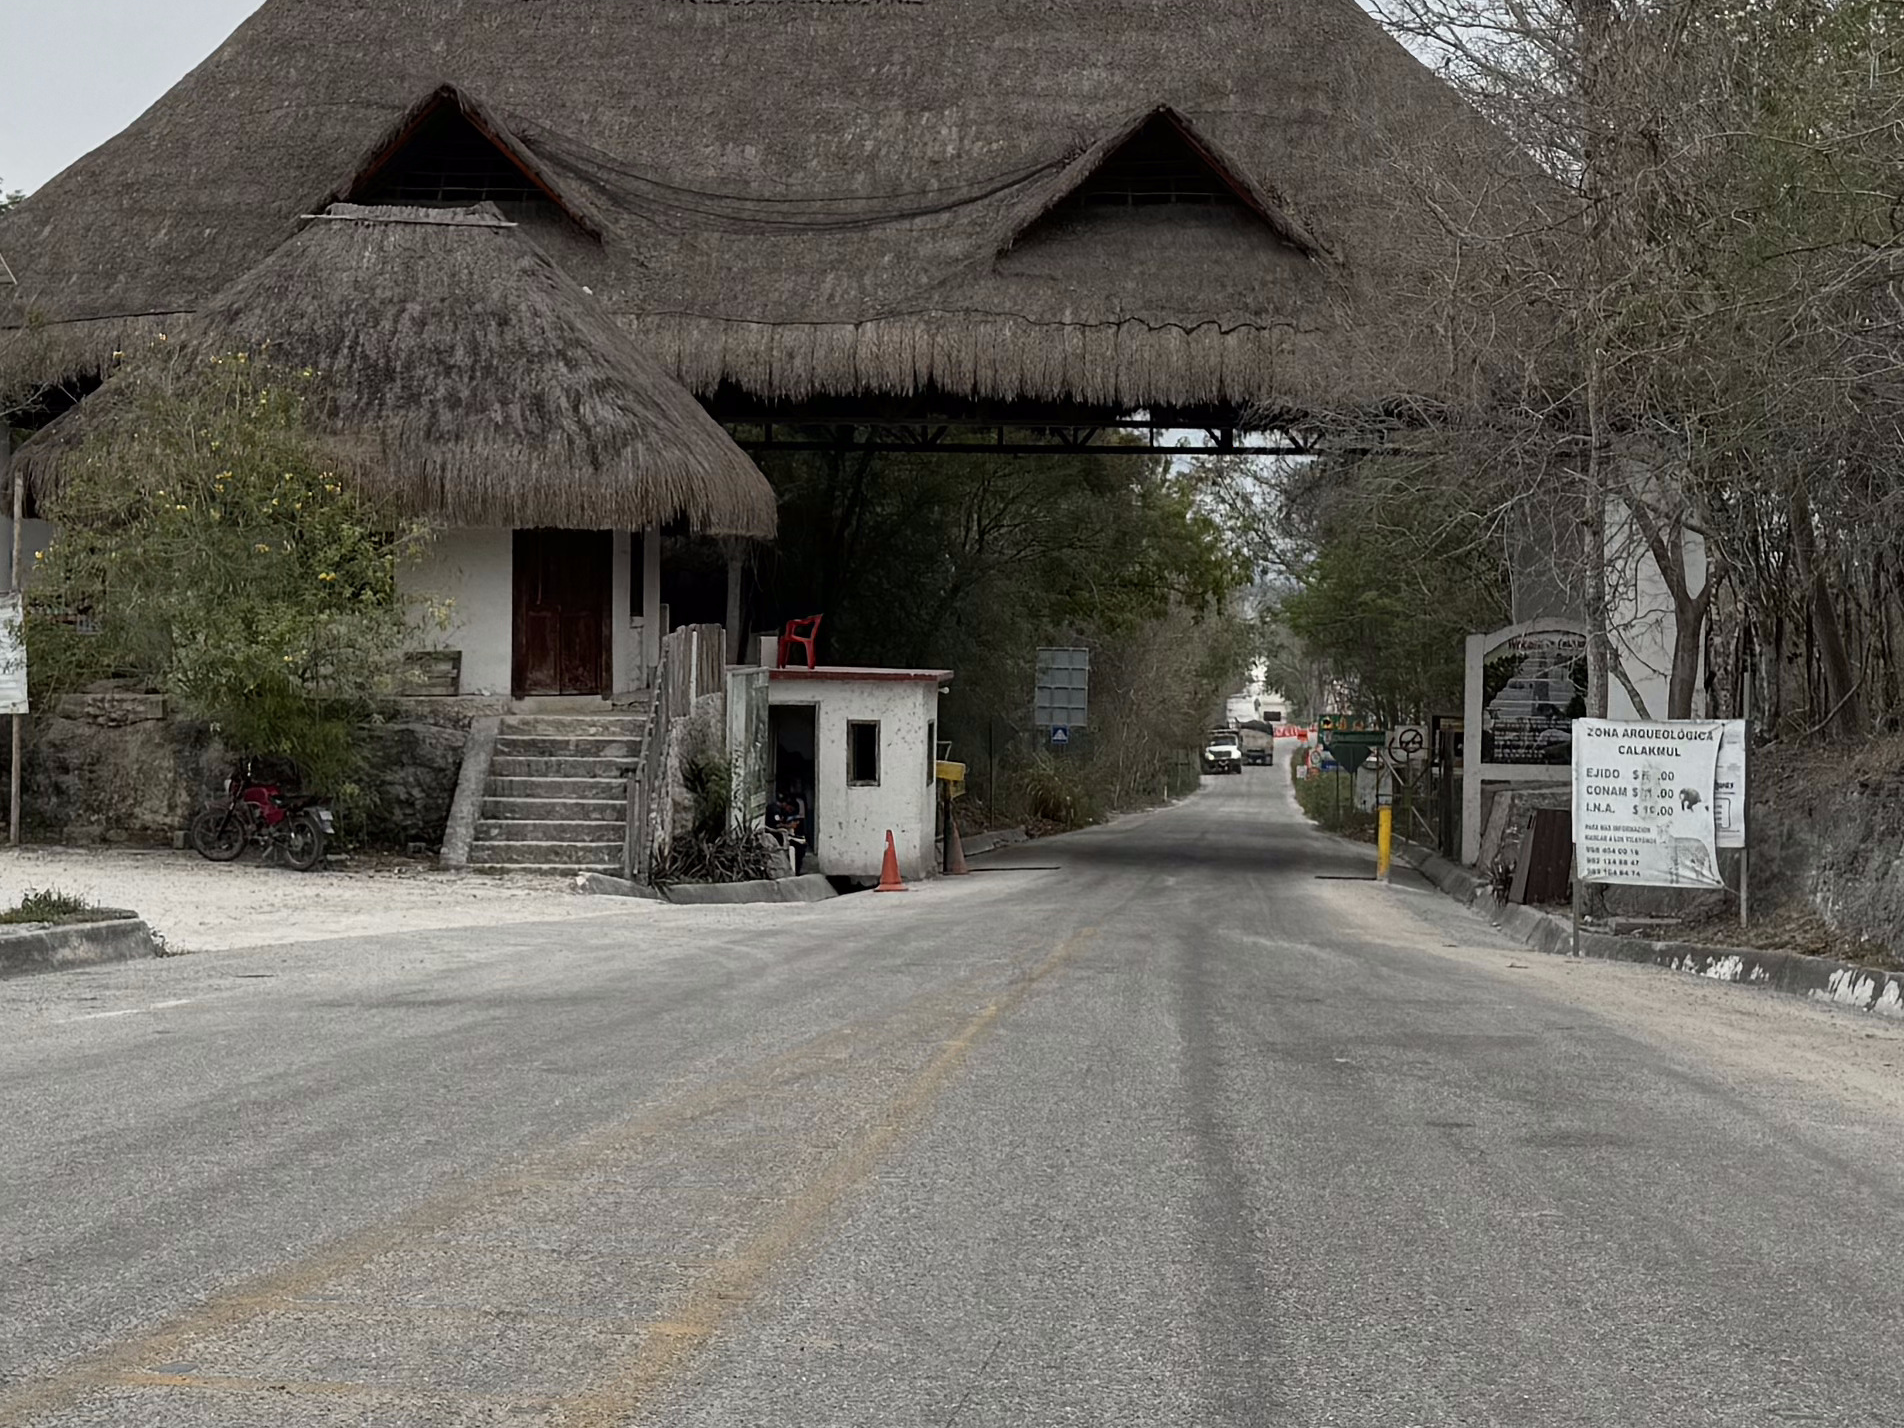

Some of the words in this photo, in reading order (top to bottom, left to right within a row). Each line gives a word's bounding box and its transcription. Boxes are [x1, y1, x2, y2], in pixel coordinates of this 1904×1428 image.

[1587, 727, 1619, 738] ZONA
[1622, 728, 1714, 741] ARQUEOLÓGICA
[1618, 745, 1681, 757] CALAKMUL
[1586, 767, 1620, 779] EJIDO
[1586, 785, 1628, 797] CONAM
